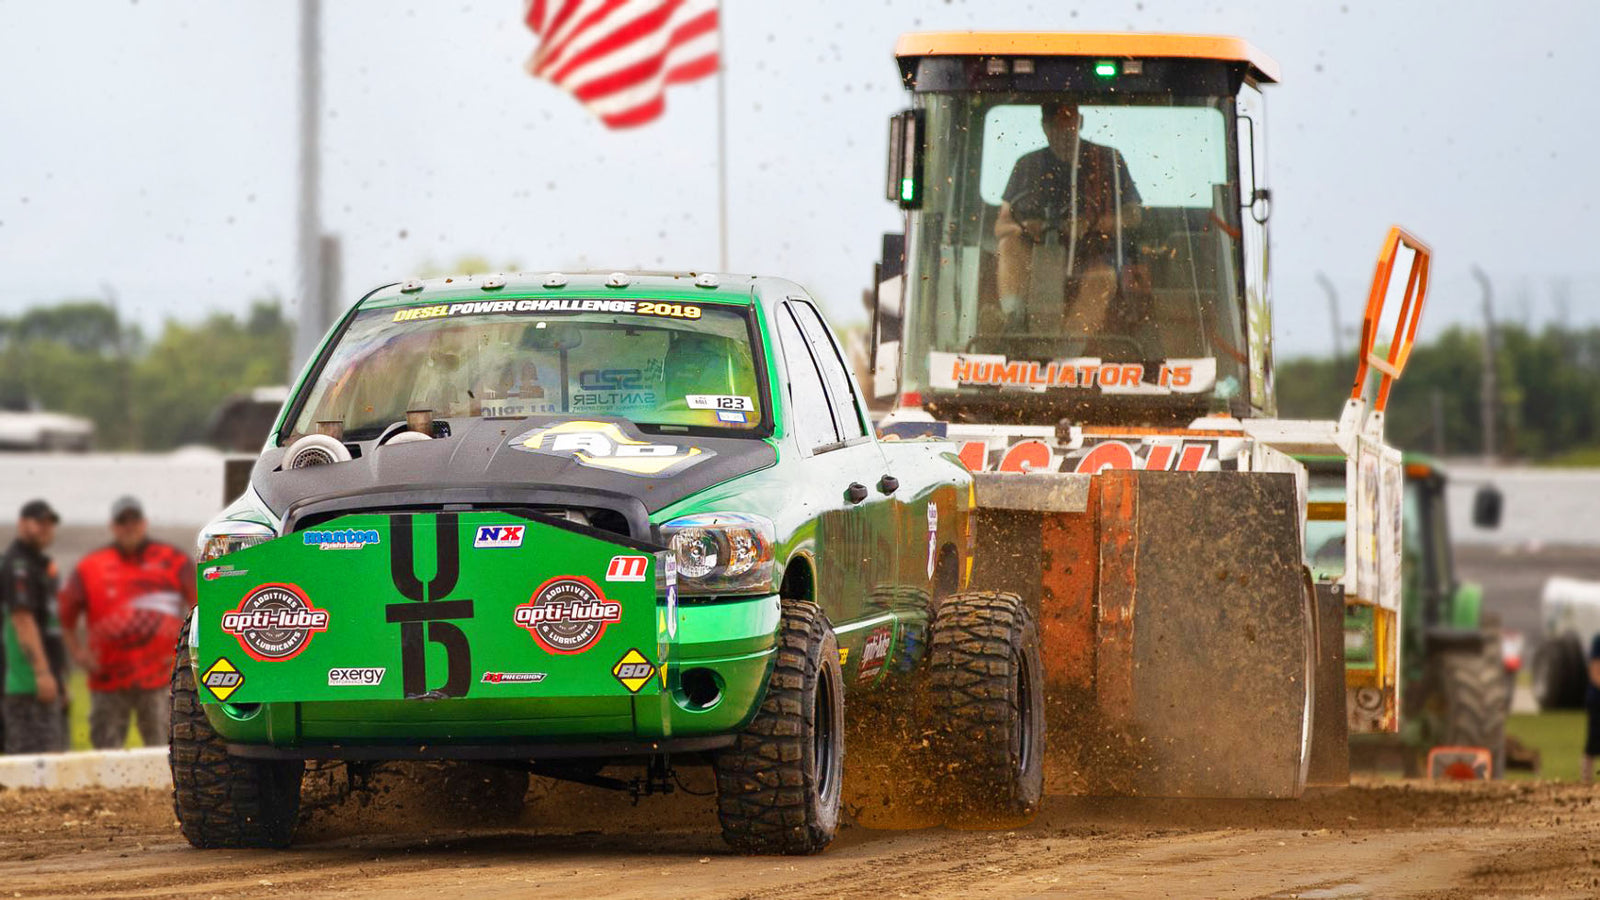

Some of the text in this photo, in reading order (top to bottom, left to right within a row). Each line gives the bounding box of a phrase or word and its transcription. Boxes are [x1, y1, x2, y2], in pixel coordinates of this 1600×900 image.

[393, 300, 701, 322] DIESEL POWER CHALLENGE 2019
[951, 360, 1144, 387] HUMILIATOR
[716, 397, 745, 409] 123
[304, 529, 379, 544] manton
[479, 527, 523, 541] NX
[253, 592, 297, 608] ADDITIVES
[546, 585, 590, 601] ADDITIVES
[224, 610, 326, 631] opti-lube
[517, 602, 618, 625] opti-lube
[255, 631, 301, 651] LUBRICANTS
[542, 624, 594, 645] & LUBRICANTS
[206, 672, 240, 686] BD
[330, 669, 384, 683] exergy
[619, 665, 651, 678] BD
